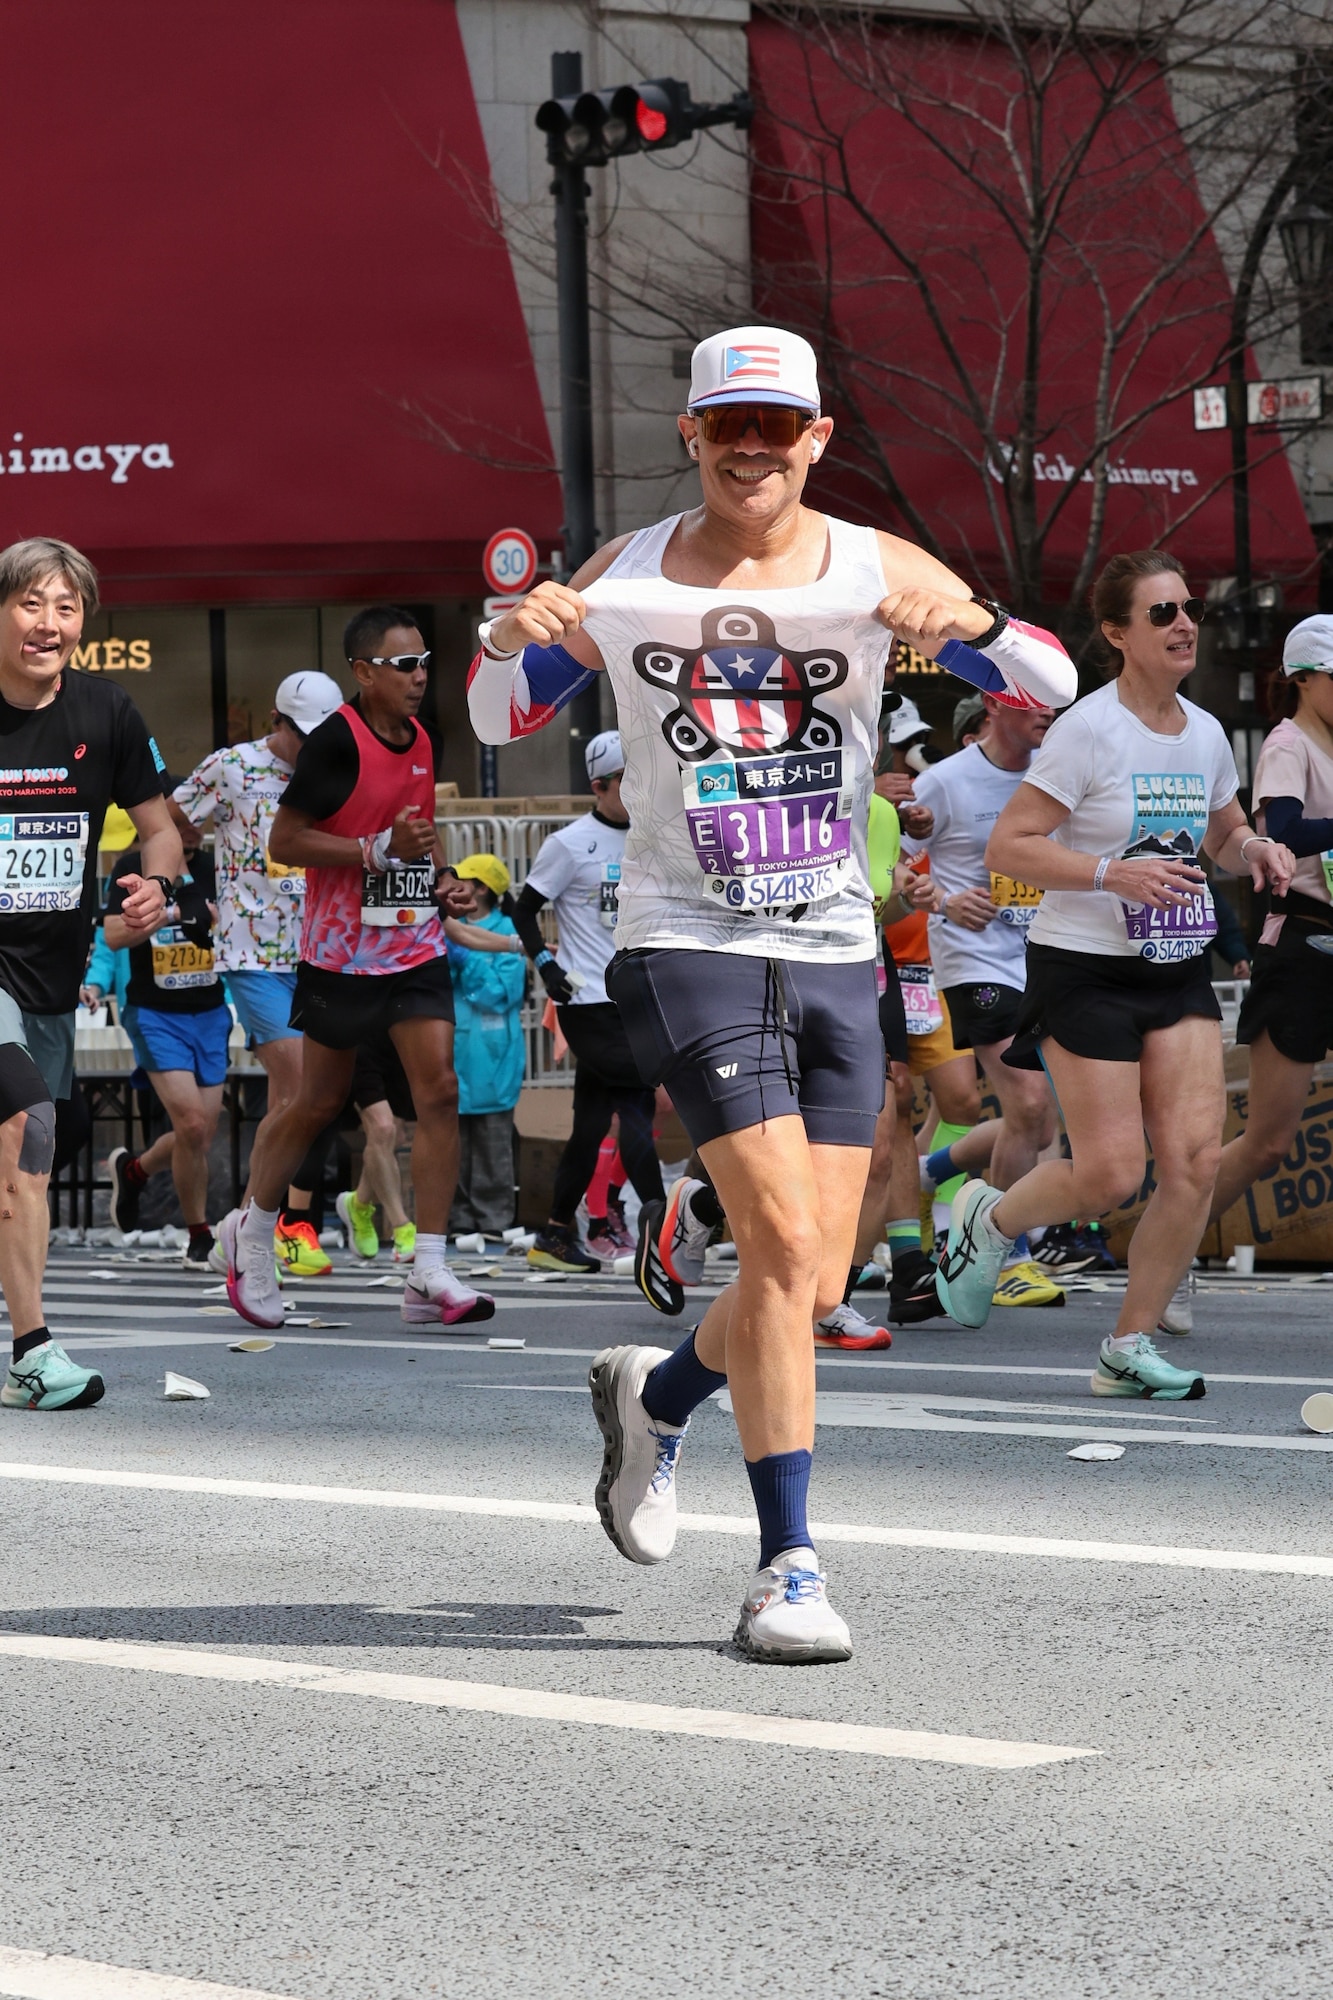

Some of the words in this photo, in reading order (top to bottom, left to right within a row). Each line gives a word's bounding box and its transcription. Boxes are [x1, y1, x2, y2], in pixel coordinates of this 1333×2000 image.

[496, 548, 525, 576] 30
[23, 767, 68, 782] TOKYO
[744, 761, 836, 790] 東京メトロ
[14, 788, 57, 796] MARATHON
[57, 787, 77, 795] 2025
[259, 791, 282, 799] 202
[1135, 776, 1205, 799] EUGENE
[1136, 798, 1206, 817] MARATHON
[18, 821, 78, 835] 東京メトロ
[695, 820, 716, 846] E
[728, 800, 834, 860] 31116
[6, 847, 73, 879] 26219
[708, 858, 721, 873] 2
[758, 861, 788, 871] TOKYO
[789, 854, 832, 868] MARATHON
[832, 848, 847, 860] 2025
[366, 874, 376, 888] F
[386, 871, 431, 898] 15029
[994, 876, 1003, 890] F
[603, 886, 613, 898] H
[367, 895, 375, 906] 2
[1133, 925, 1142, 938] 2
[155, 951, 165, 961] D
